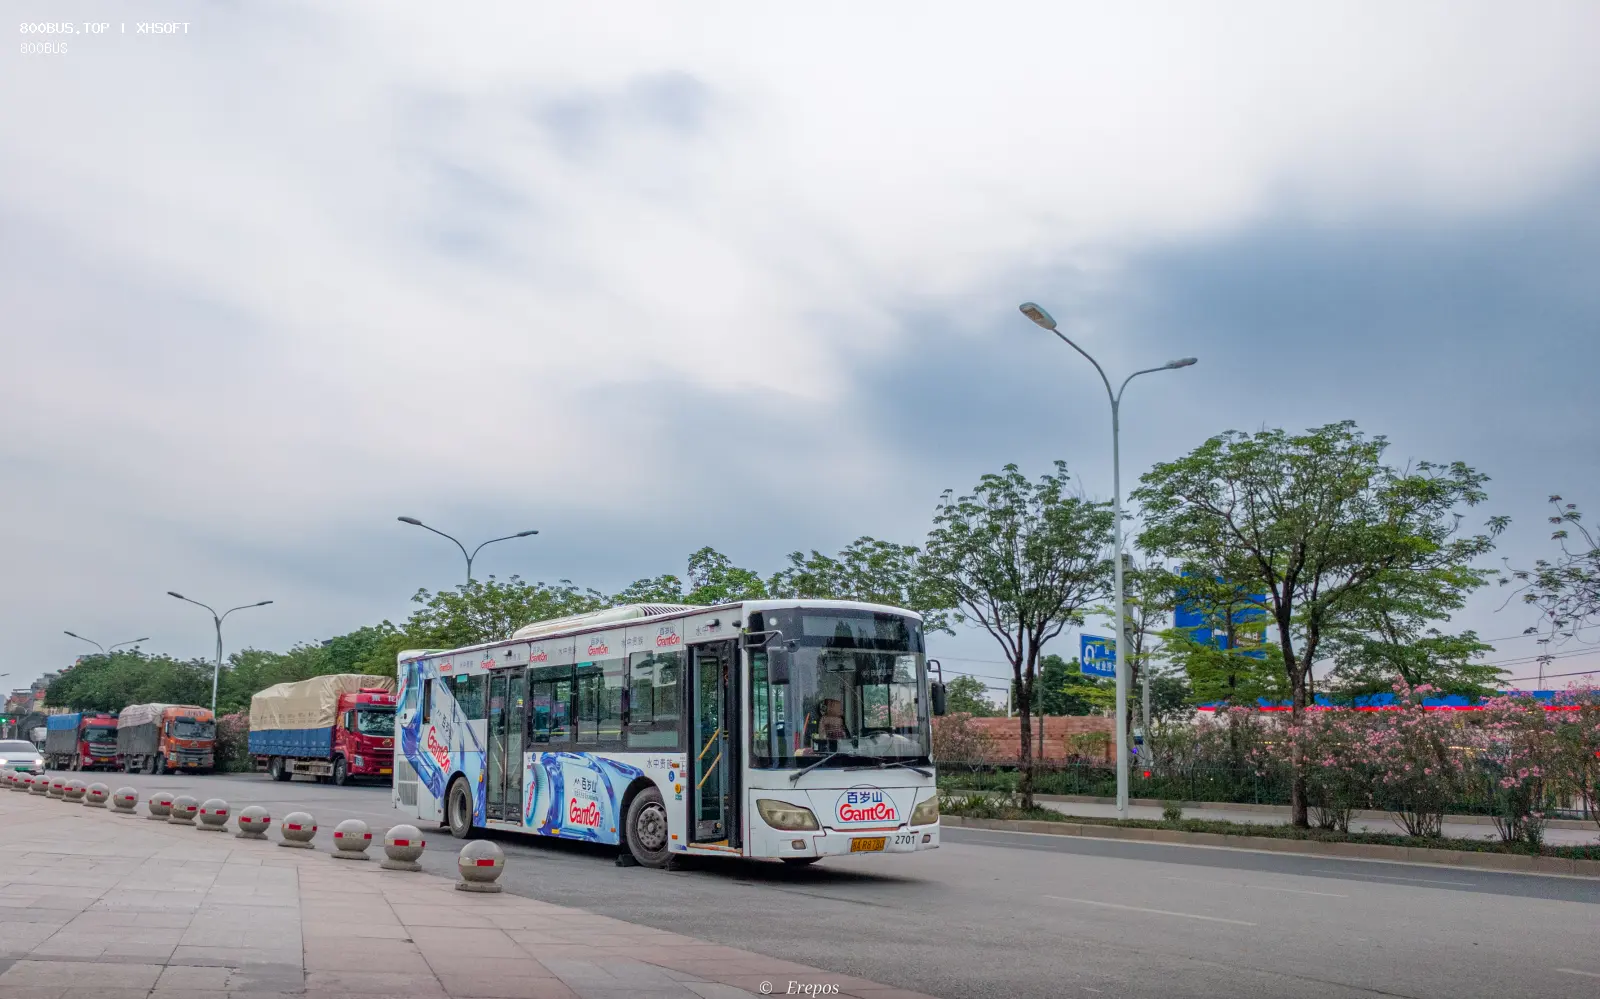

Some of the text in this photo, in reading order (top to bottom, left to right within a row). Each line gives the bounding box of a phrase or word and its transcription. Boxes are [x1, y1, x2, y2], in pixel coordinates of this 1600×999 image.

[847, 791, 882, 803] 百岁山
[895, 835, 915, 844] 2701
